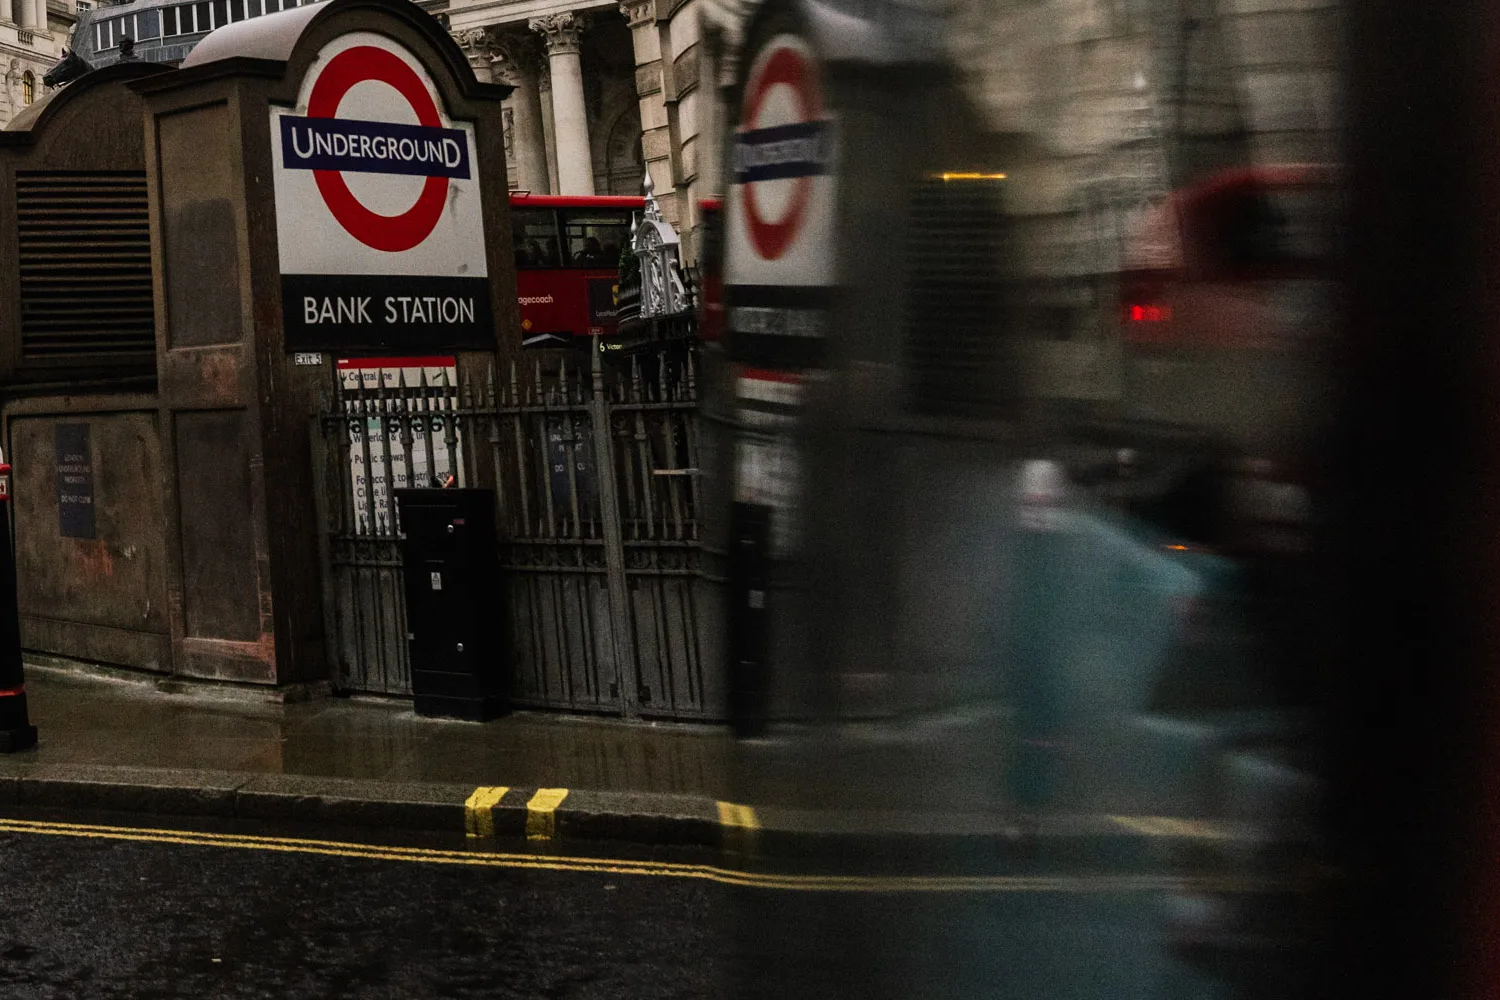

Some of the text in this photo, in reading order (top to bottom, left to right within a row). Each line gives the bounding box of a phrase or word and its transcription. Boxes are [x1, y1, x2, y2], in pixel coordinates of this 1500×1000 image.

[291, 126, 462, 169] UNDERGROUND
[517, 293, 554, 306] agecoach
[303, 296, 475, 325] BANK STATION
[599, 341, 606, 353] 6
[295, 353, 321, 364] Exit 5
[348, 371, 377, 381] Cetral
[397, 473, 406, 482] to
